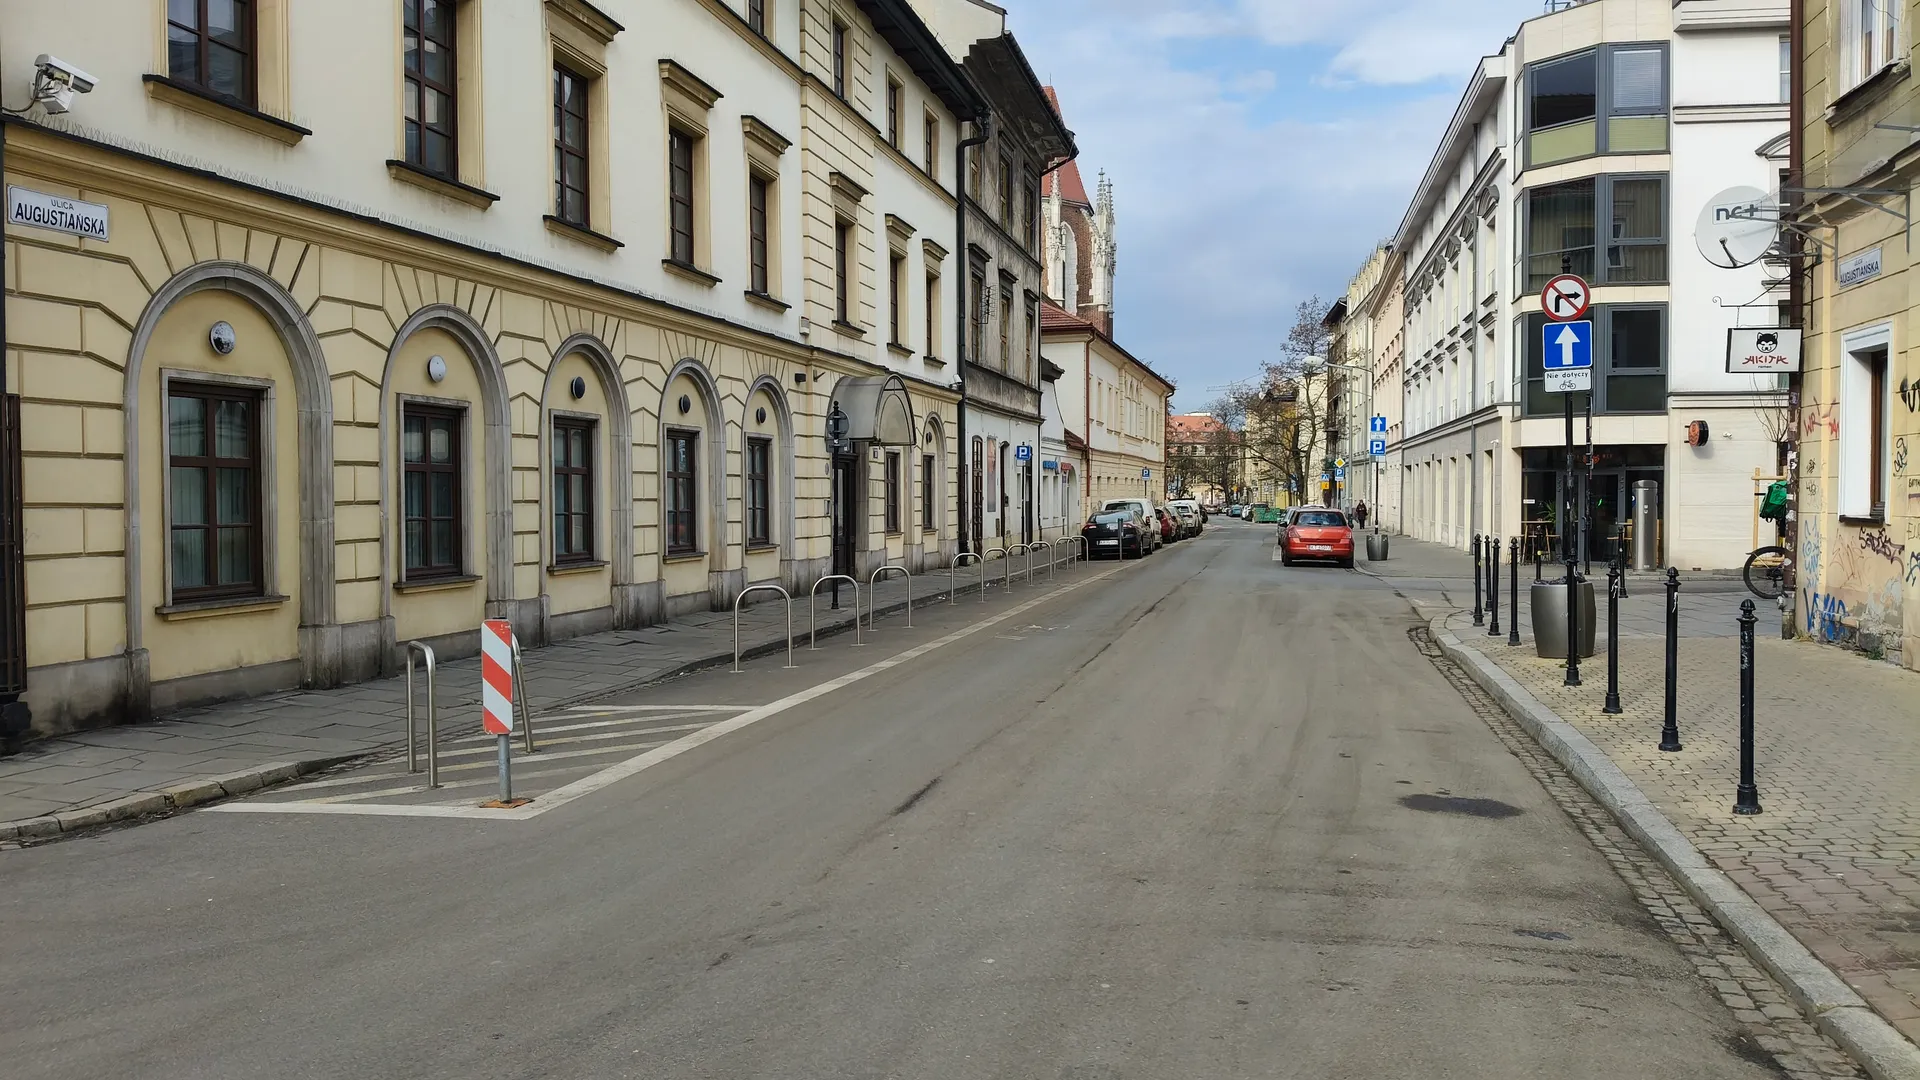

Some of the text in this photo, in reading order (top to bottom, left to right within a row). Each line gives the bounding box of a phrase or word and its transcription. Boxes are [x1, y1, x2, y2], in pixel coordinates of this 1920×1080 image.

[50, 199, 75, 211] ULICA
[15, 202, 105, 236] AUGUSTIAŃSKA
[1742, 355, 1789, 365] AKITA
[1561, 371, 1589, 379] dotyczy
[1019, 447, 1028, 458] P
[1373, 441, 1383, 454] P
